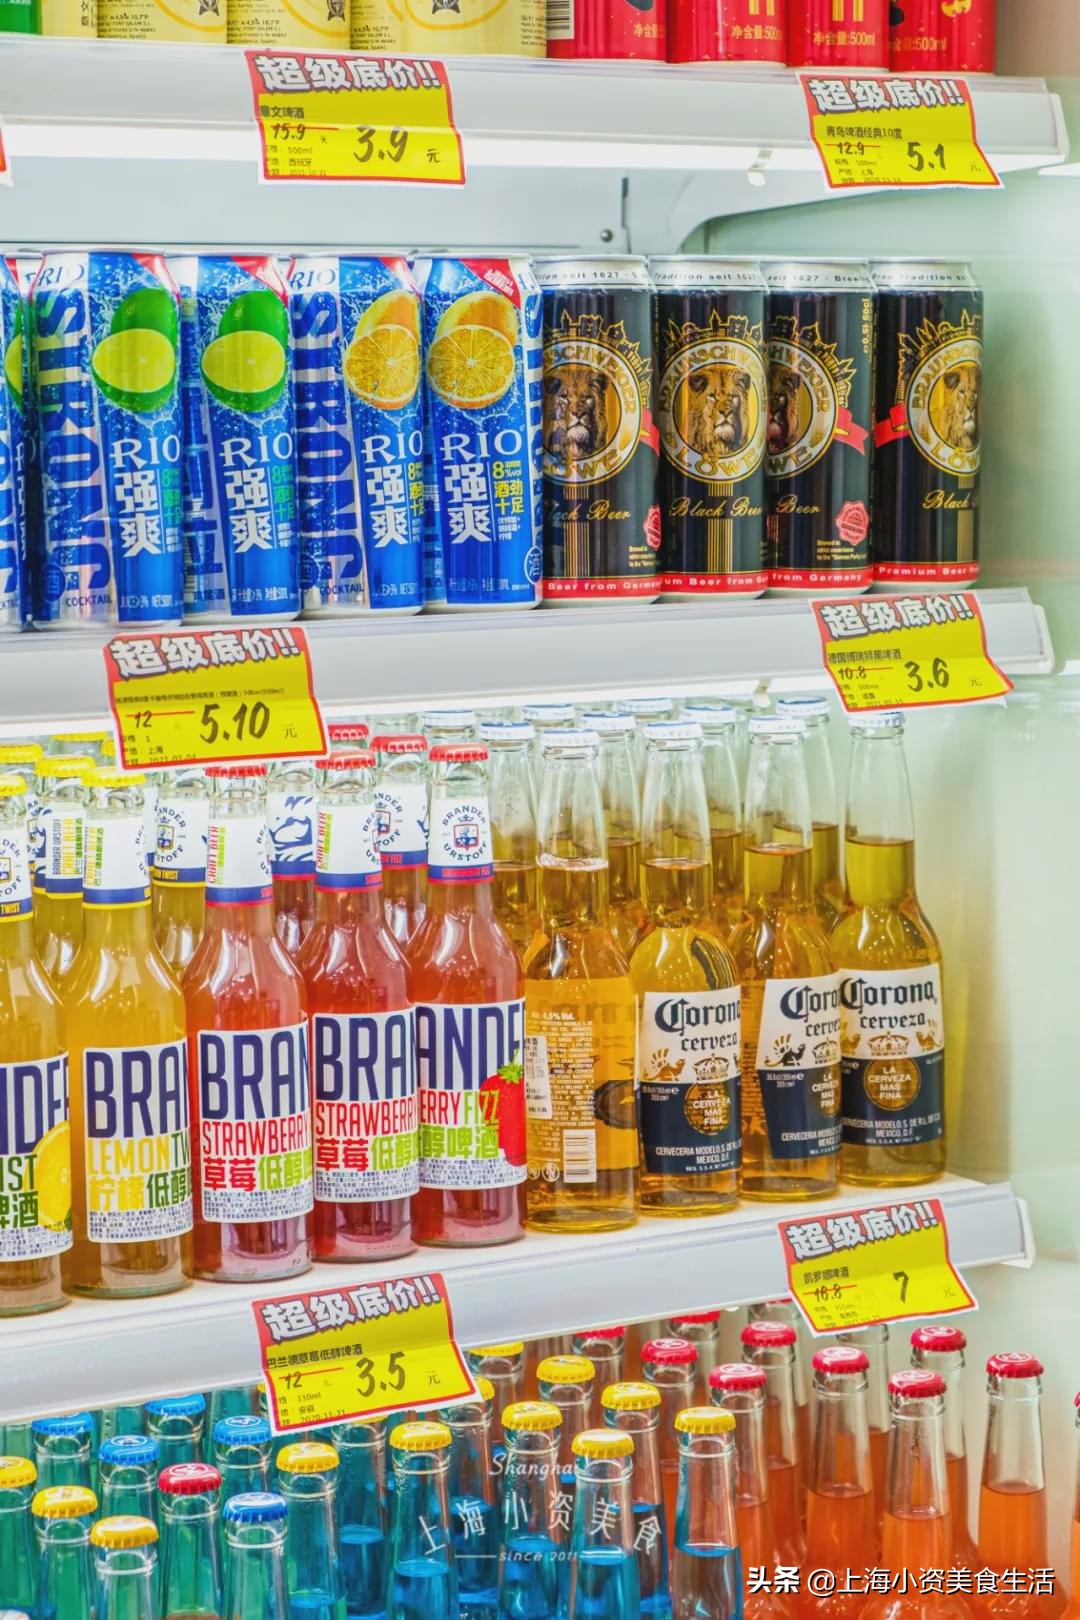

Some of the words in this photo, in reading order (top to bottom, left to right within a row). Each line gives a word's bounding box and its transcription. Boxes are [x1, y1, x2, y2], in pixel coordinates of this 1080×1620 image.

[254, 56, 441, 94] 超级底价!!
[808, 79, 965, 115] 超级底价!!
[271, 122, 306, 140] 15.9
[354, 125, 409, 163] 3.9
[426, 148, 440, 163] 元
[838, 141, 865, 156] 12.9
[907, 141, 946, 171] 5.1
[290, 269, 337, 288] RIO
[109, 434, 180, 469] RIO
[219, 432, 293, 468] RIO
[360, 430, 423, 464] RIO
[440, 429, 521, 462] RIO
[492, 461, 505, 479] 8
[494, 480, 523, 498] 酒劲
[922, 489, 970, 510] Black
[113, 469, 162, 557] 强爽
[224, 467, 274, 553] 强爽
[365, 464, 409, 548] 强爽
[443, 462, 492, 544] 强爽
[495, 498, 524, 516] 十足
[586, 498, 632, 520] Beer
[668, 496, 724, 517] Black
[776, 494, 821, 514] Beer
[689, 577, 721, 586] Beer
[727, 576, 754, 585] from
[772, 572, 803, 581] from
[809, 572, 863, 583] Germany
[879, 566, 937, 575] Premium
[320, 583, 365, 596] COCKTAIL
[548, 582, 578, 590] Beer
[584, 581, 617, 590] from
[66, 595, 112, 607] COCKTAIL
[821, 594, 975, 641] 超级底价!!
[110, 629, 301, 681] 超级底价!!
[838, 665, 866, 680] 10.8
[904, 657, 950, 692] 3.6
[134, 710, 152, 728] 12
[200, 700, 271, 744] 5.10
[283, 723, 297, 740] 元
[442, 804, 487, 827] BRANDER
[443, 841, 487, 862] URSTOFF
[841, 977, 937, 1014] Corona
[860, 1011, 925, 1030] cerveza
[868, 1074, 912, 1084] CERVEZA
[883, 1066, 897, 1075] LA
[707, 1090, 720, 1098] LA
[879, 1083, 902, 1091] MAS
[879, 1091, 902, 1100] FINA
[463, 1089, 500, 1127] FIZZ
[875, 1120, 901, 1129] MODELO
[781, 1130, 817, 1142] CERVECERIA
[87, 1133, 170, 1176] LEMON
[655, 1147, 695, 1157] CERVECERIA
[786, 1200, 939, 1262] 超级底价!!
[893, 1271, 910, 1304] 7
[261, 1275, 441, 1344] 超级底价!!
[284, 1371, 303, 1390] 12
[356, 1352, 406, 1398] 3.5
[427, 1370, 441, 1386] 元
